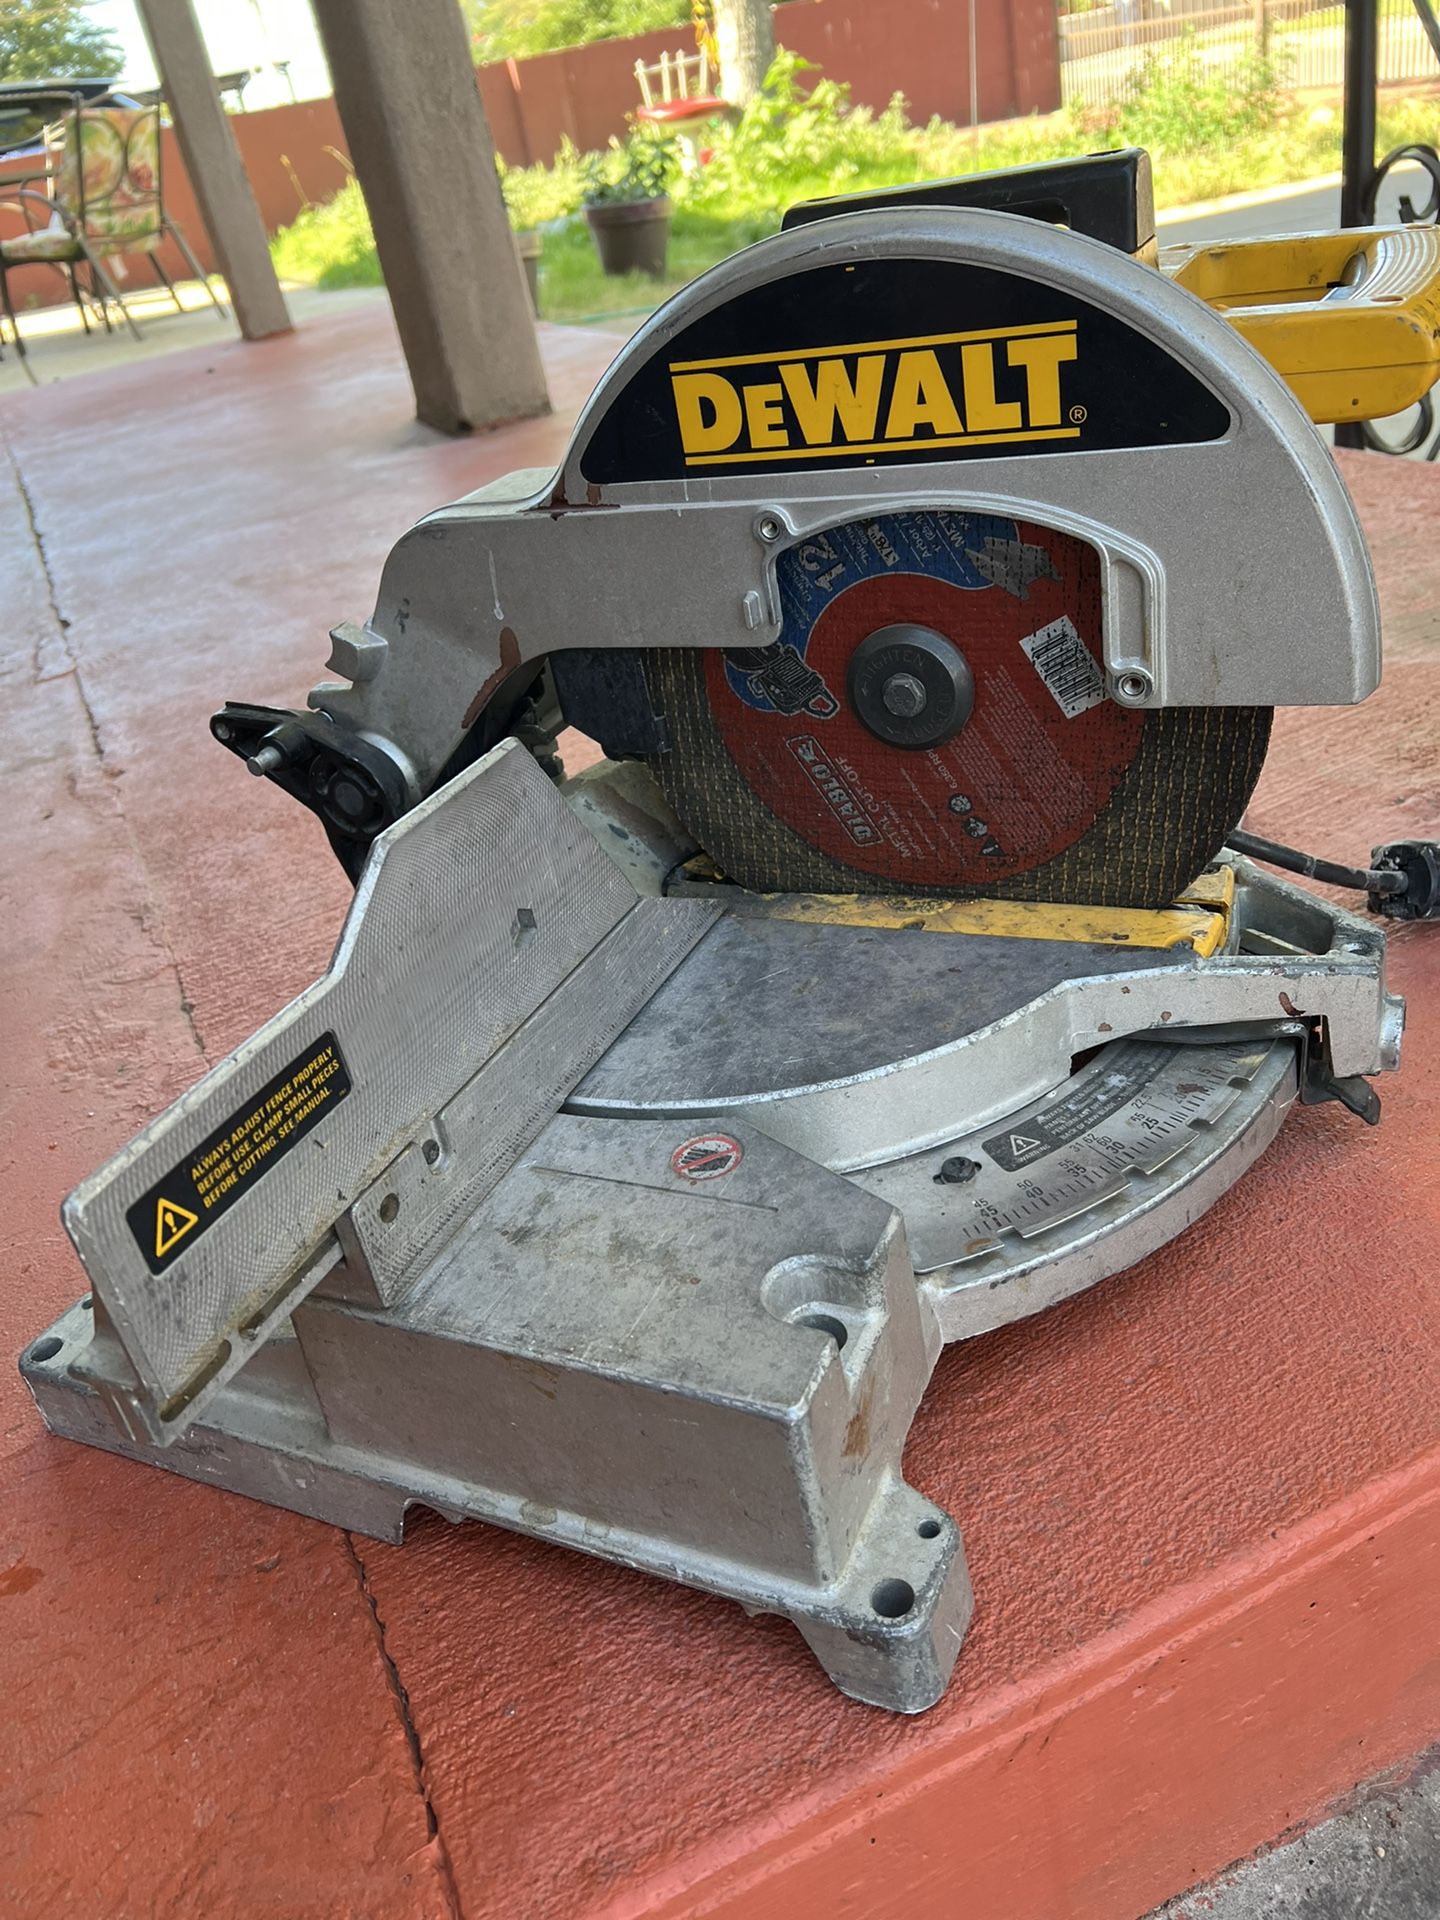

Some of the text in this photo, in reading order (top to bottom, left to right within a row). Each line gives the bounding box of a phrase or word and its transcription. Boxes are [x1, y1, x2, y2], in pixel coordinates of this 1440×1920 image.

[672, 333, 1077, 453] DEWALT
[905, 526, 932, 560] Arbor
[924, 745, 942, 766] RP
[811, 763, 873, 841] DIABLO
[834, 754, 912, 858] METAL CUT-OFF
[190, 1045, 332, 1181] ALWAYS ADJUST FENCE PROPERLY
[197, 1155, 232, 1195] BEFORE
[253, 1109, 283, 1143] CLAMP
[285, 1084, 311, 1115] SMALL
[312, 1058, 338, 1089] PIECES
[1140, 1115, 1160, 1131] 25
[1083, 1132, 1098, 1144] 62
[1098, 1135, 1112, 1147] 60
[1106, 1140, 1125, 1156] 30
[204, 1171, 237, 1209] BEFORE
[278, 1118, 293, 1139] SEE
[1058, 1157, 1074, 1171] 55
[1069, 1163, 1086, 1178] 35
[1017, 1179, 1032, 1191] 50
[1025, 1185, 1043, 1200] 40
[980, 1203, 998, 1219] 45
